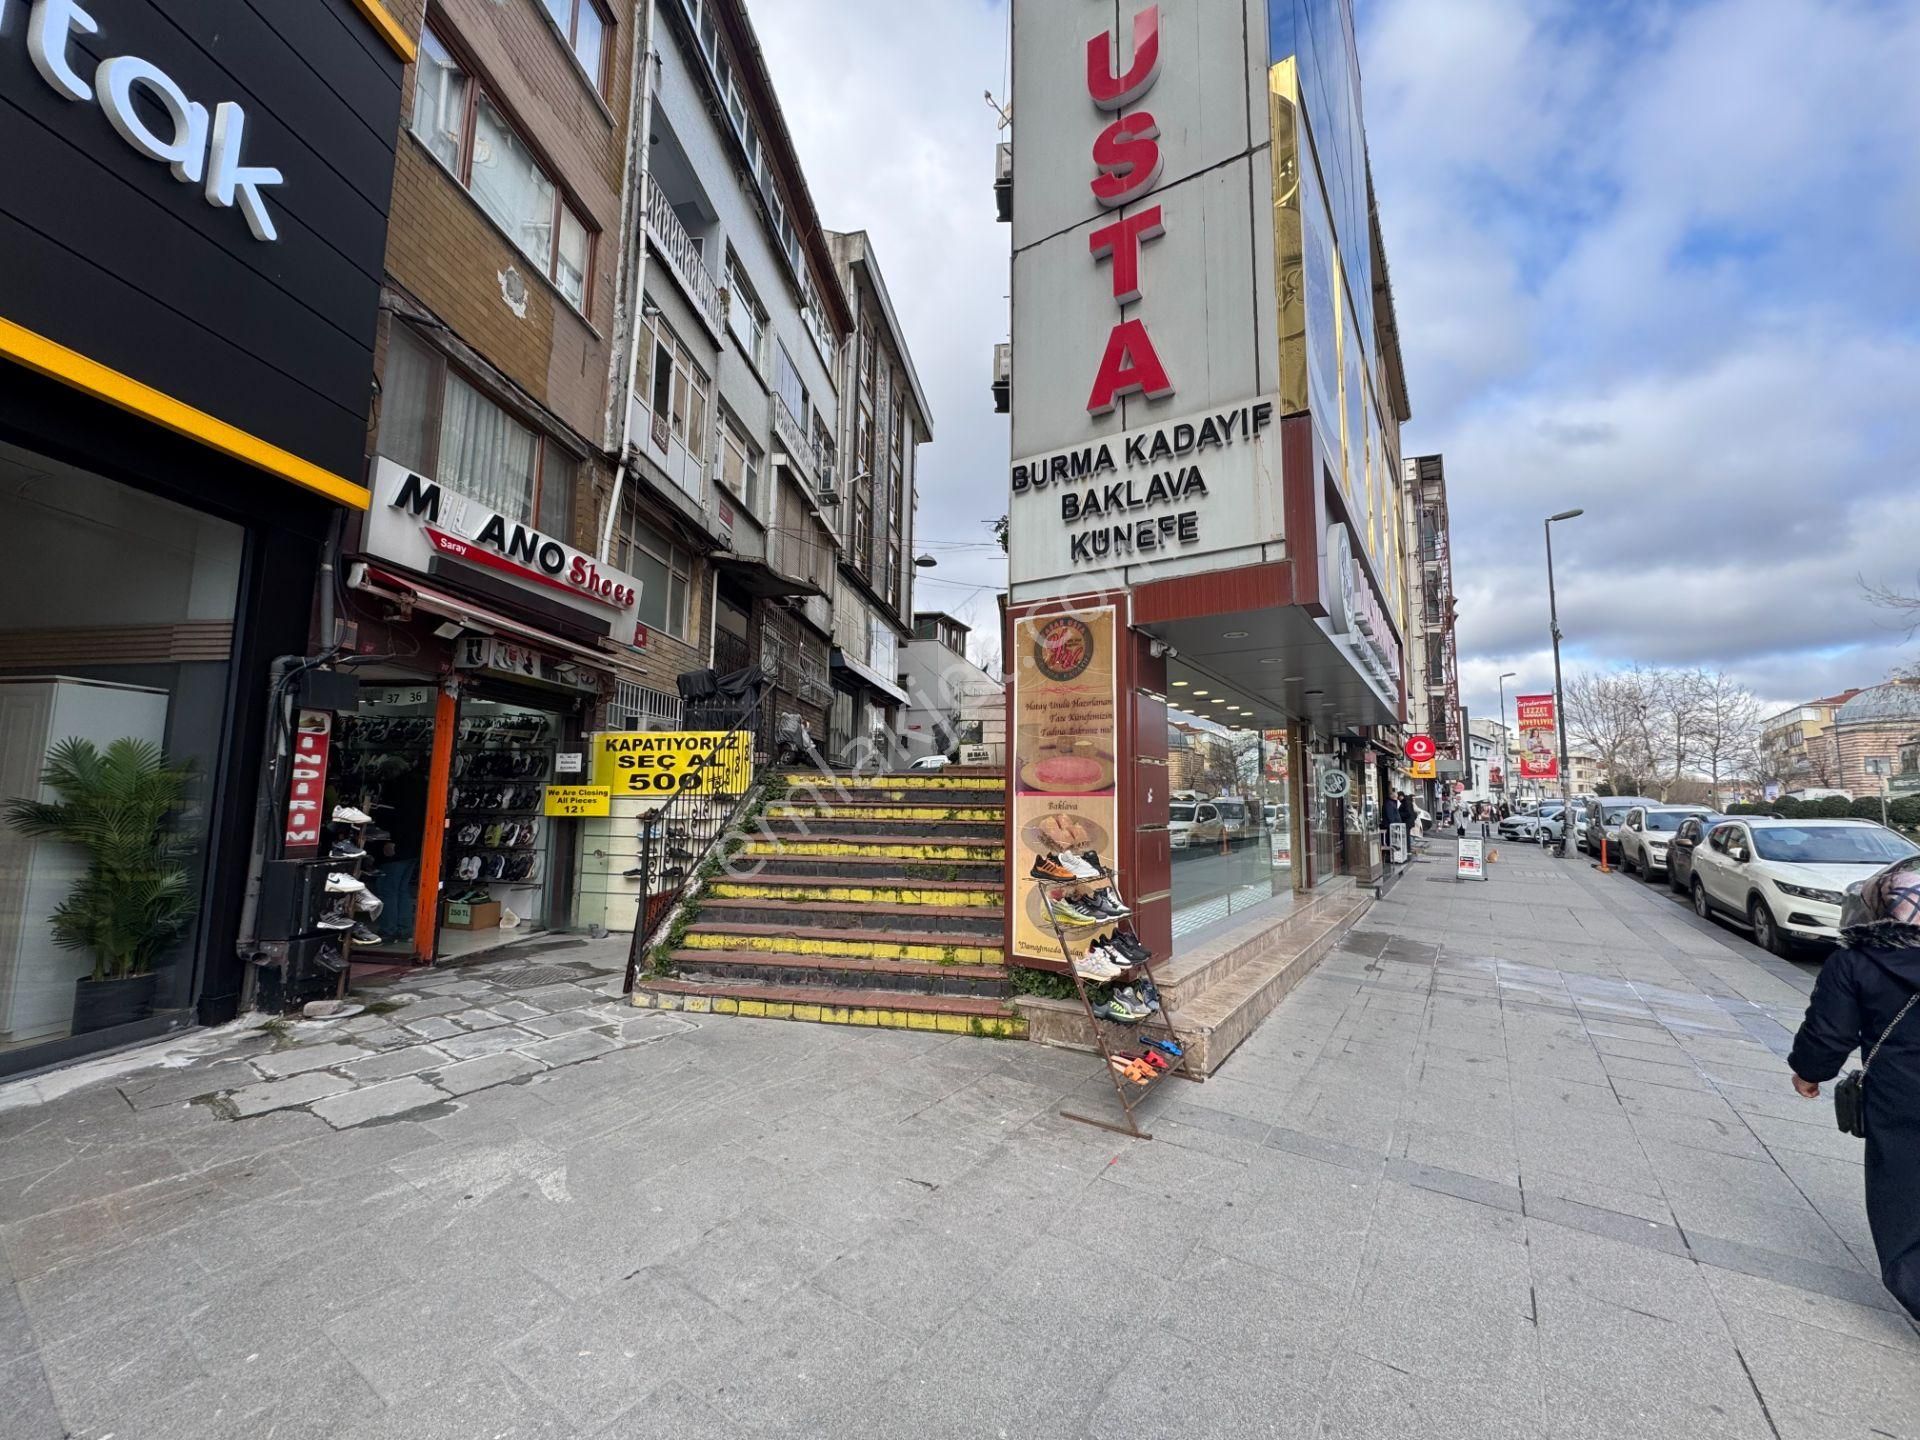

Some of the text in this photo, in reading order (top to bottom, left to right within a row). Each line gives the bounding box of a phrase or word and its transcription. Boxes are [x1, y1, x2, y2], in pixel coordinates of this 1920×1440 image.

[1086, 3, 1176, 417] USTA
[1012, 402, 1272, 493] BURMA KADAYIF
[1062, 465, 1208, 522] BAKLAVA
[1071, 511, 1200, 562] KÜNEFE
[440, 538, 467, 555] Saray
[566, 555, 635, 607] Shoes
[387, 692, 422, 703] 37 36
[1050, 713, 1066, 723] Taze
[606, 737, 739, 752] KAPATIYORUZ
[617, 754, 726, 771] SEÇ AL
[628, 773, 702, 791] 500
[578, 789, 609, 798] Closing
[564, 805, 578, 814] 12
[1047, 801, 1078, 811] Baklava
